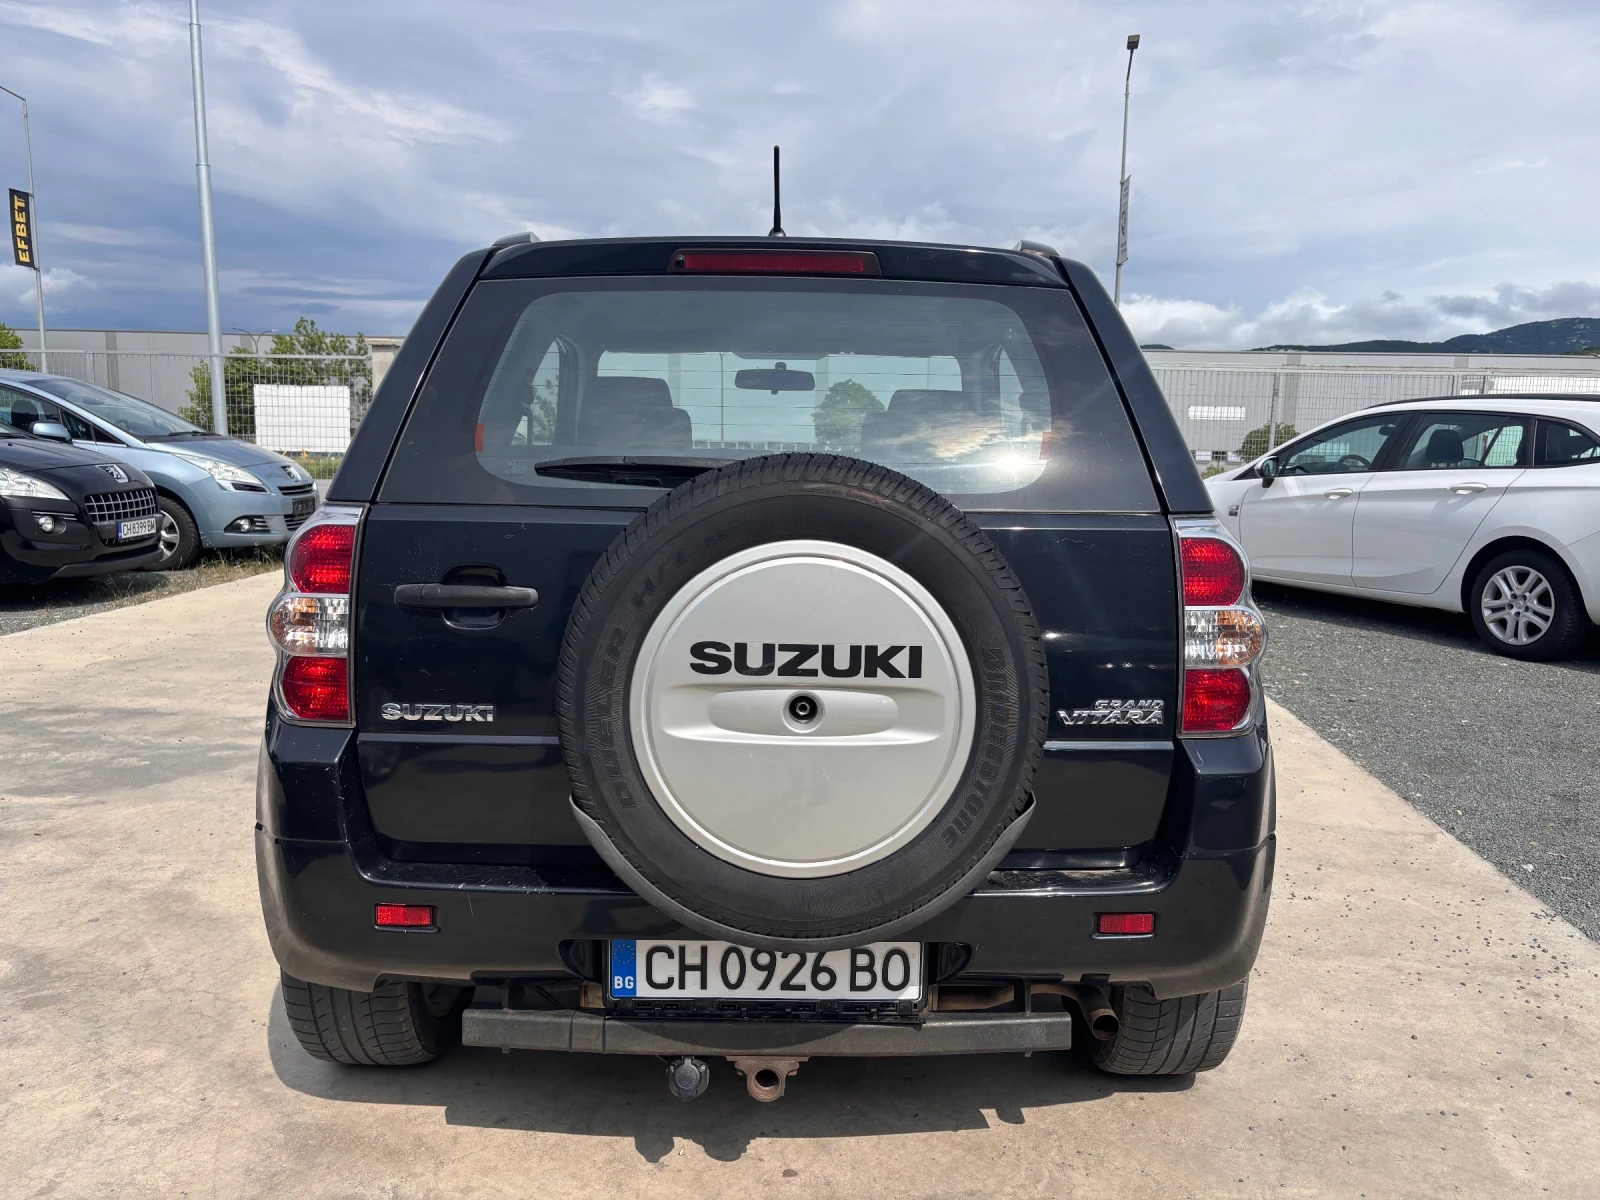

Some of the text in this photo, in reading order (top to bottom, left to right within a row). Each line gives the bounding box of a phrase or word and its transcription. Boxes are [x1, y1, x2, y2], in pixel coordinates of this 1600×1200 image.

[14, 195, 30, 263] EFBET
[689, 641, 922, 679] SUZUKI
[381, 702, 495, 722] SUZUKI
[1094, 699, 1165, 710] GRAND
[1057, 710, 1164, 725] VITARA
[645, 944, 911, 992] CH 0926 BO
[613, 975, 635, 989] BG
